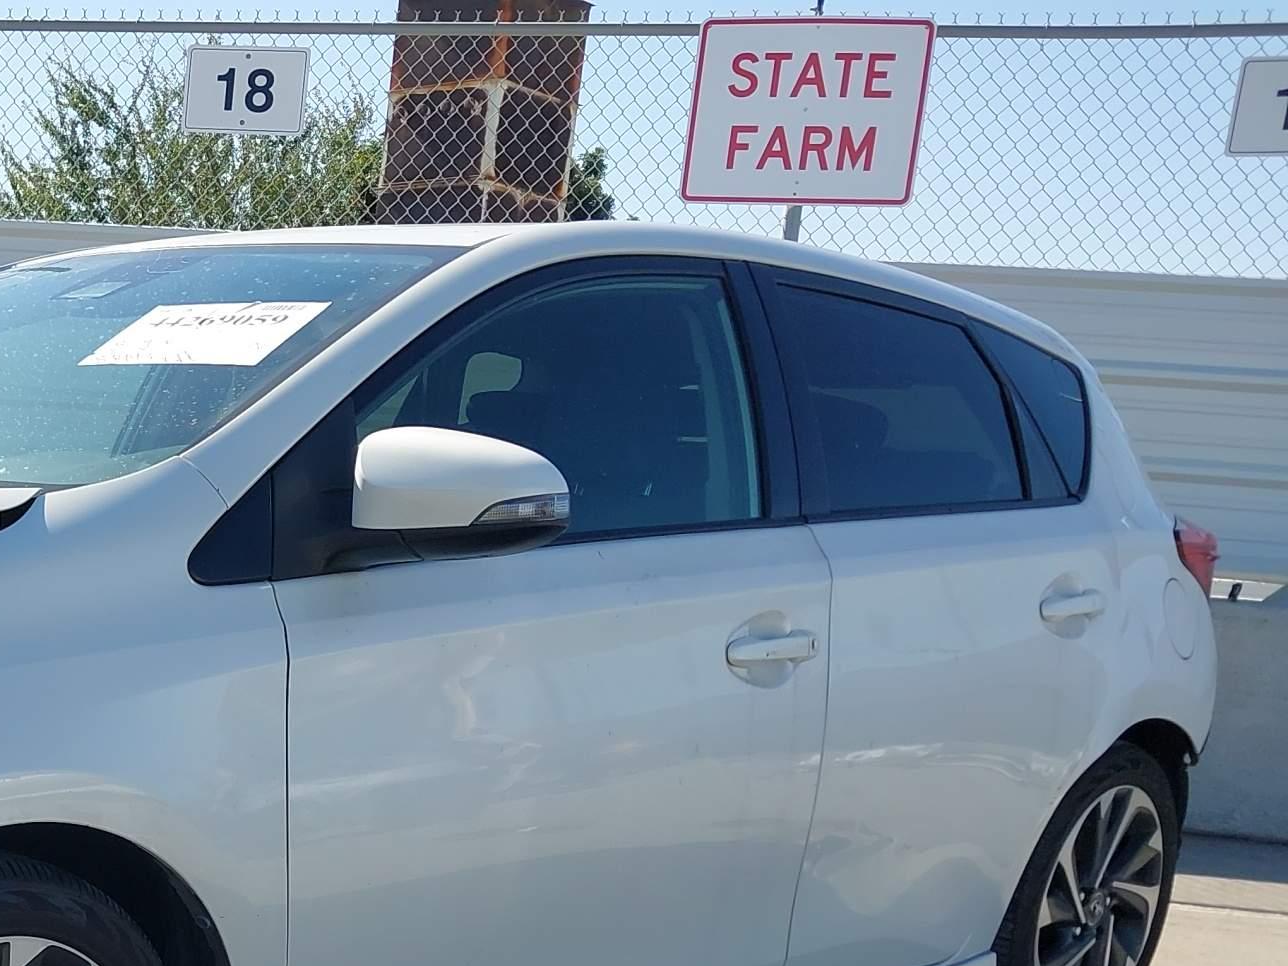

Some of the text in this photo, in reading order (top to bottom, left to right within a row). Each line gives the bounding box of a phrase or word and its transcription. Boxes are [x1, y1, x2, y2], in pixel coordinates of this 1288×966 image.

[217, 67, 275, 113] 18
[728, 52, 897, 99] STATE
[726, 124, 877, 171] FARM
